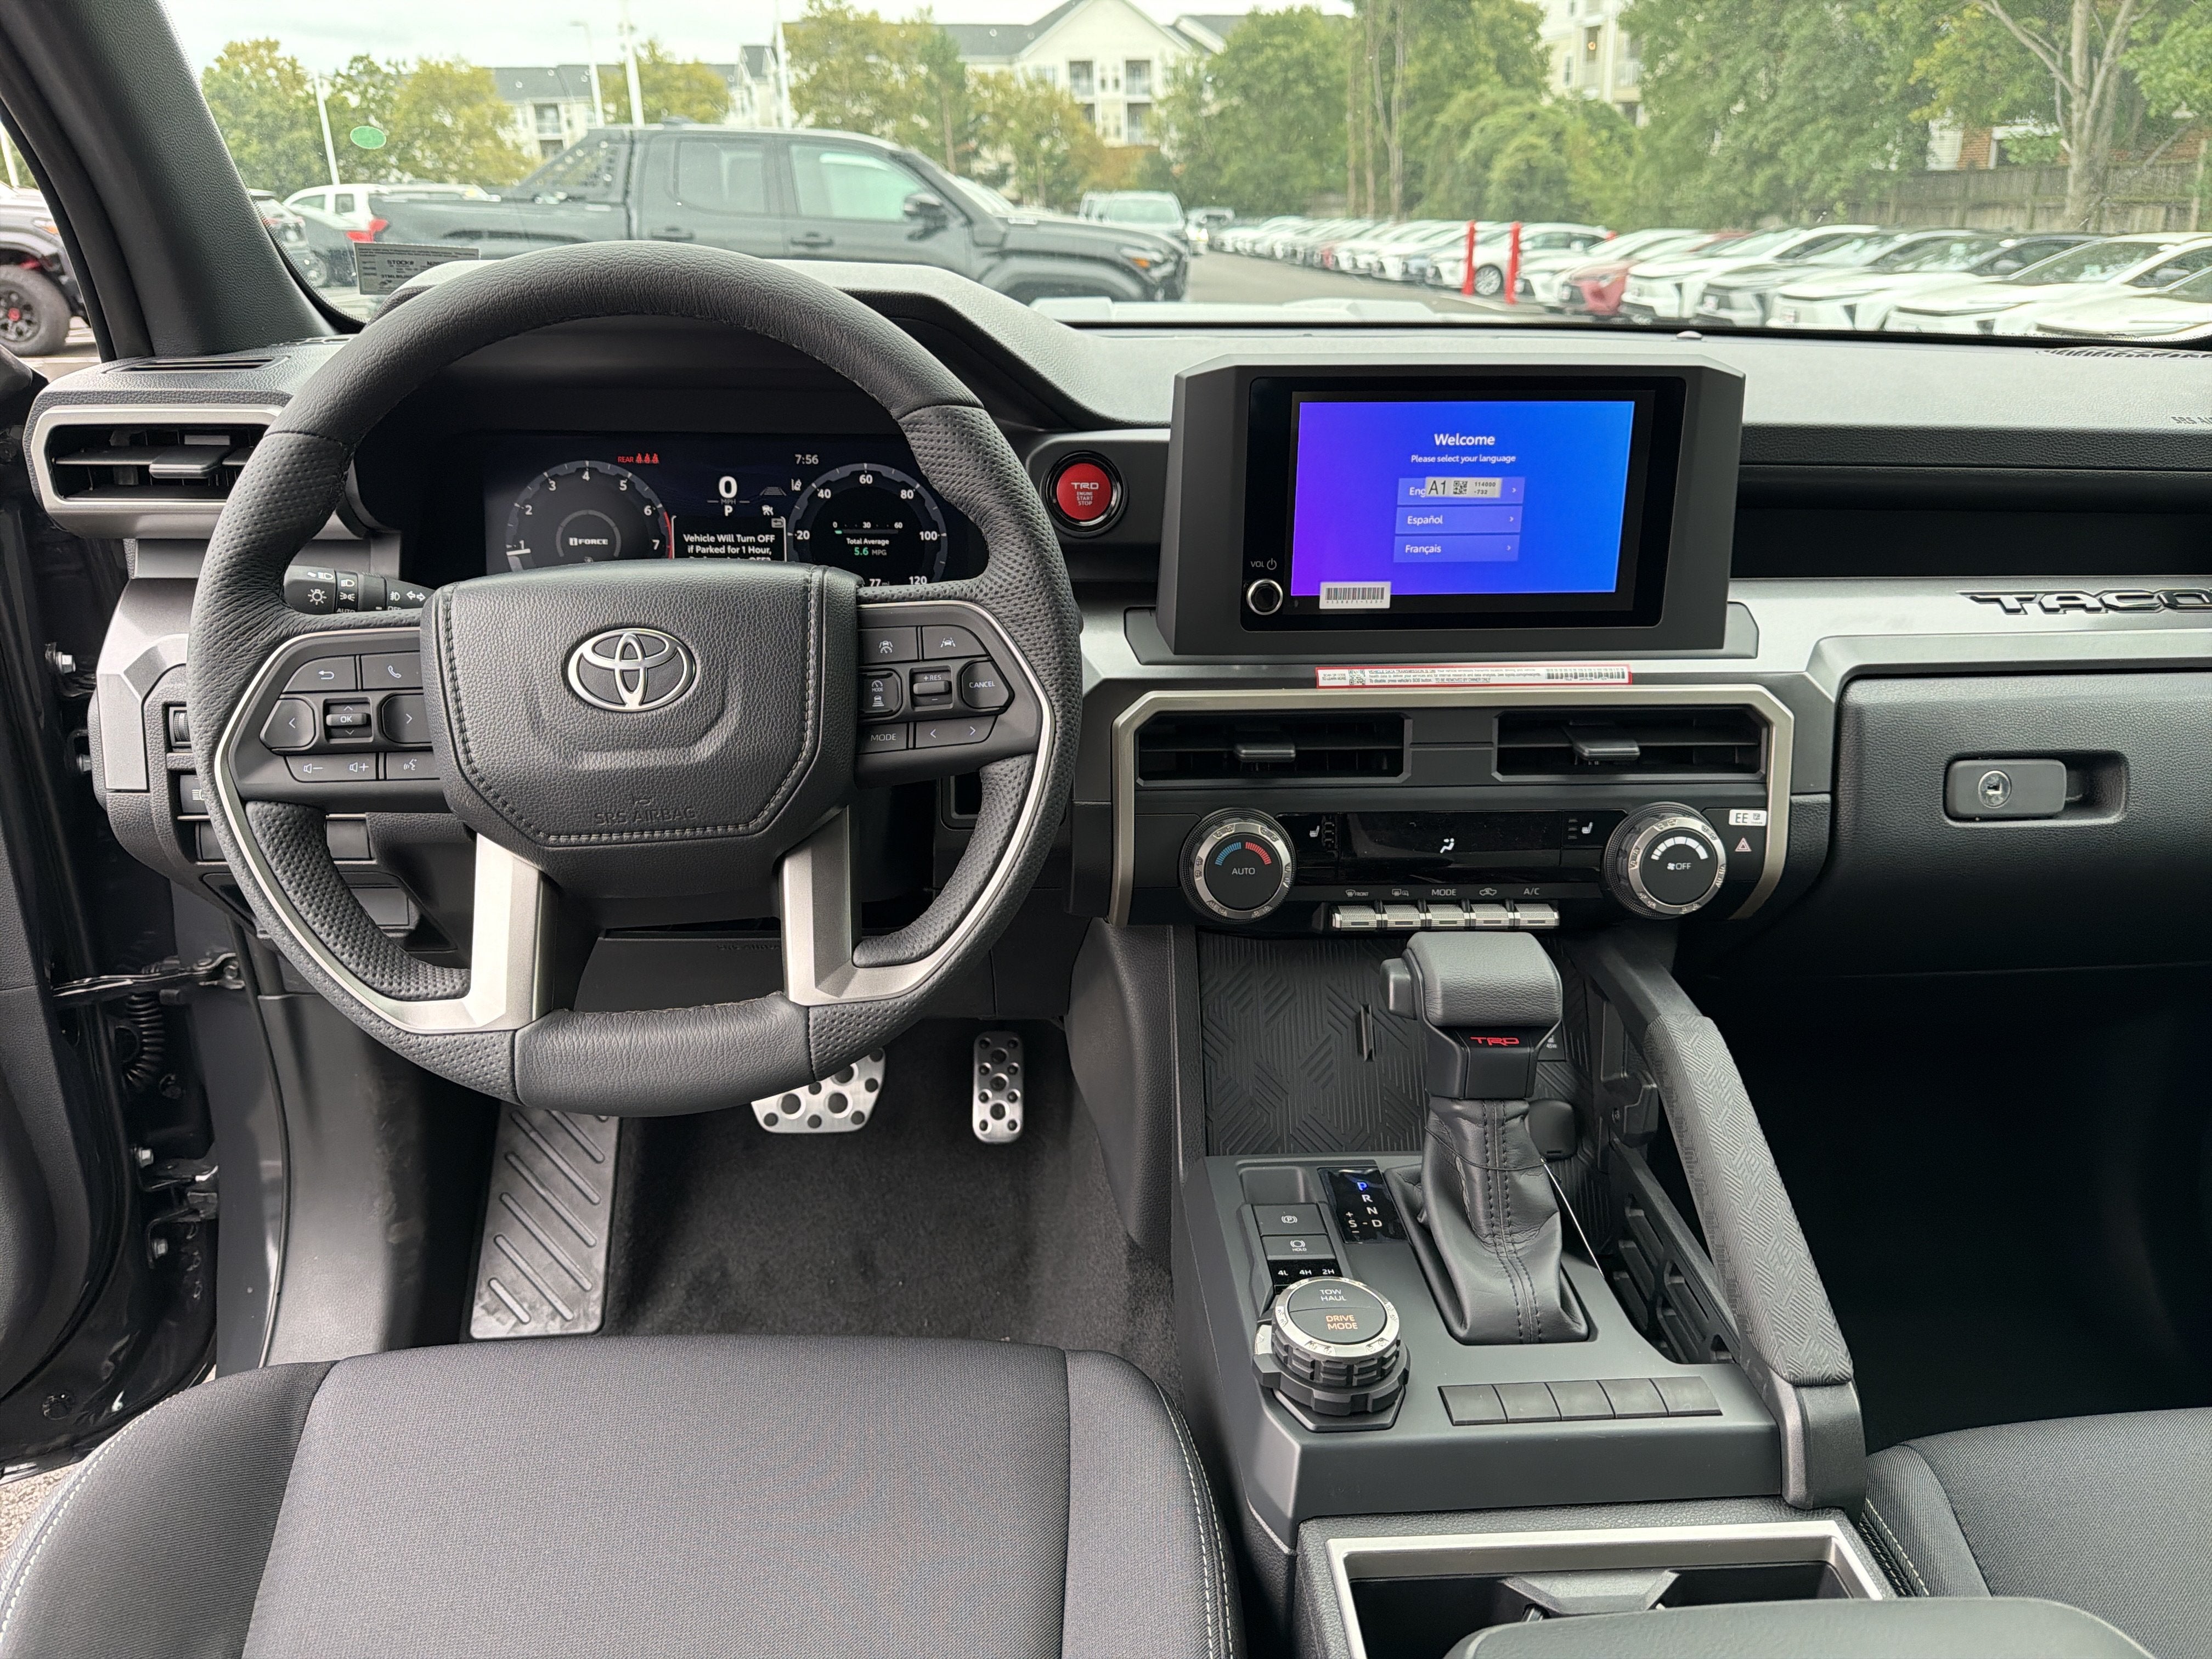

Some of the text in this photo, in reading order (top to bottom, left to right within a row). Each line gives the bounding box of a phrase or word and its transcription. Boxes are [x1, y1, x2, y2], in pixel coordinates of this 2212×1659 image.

[1434, 433, 1496, 446] Welcome
[794, 454, 819, 465] 7:56
[1437, 454, 1459, 462] select
[1460, 455, 1479, 464] your
[1480, 454, 1516, 464] language
[582, 471, 590, 481] 4
[859, 475, 873, 484] 60
[549, 480, 556, 491] 3
[619, 480, 627, 491] 5
[719, 476, 737, 498] 0
[1428, 480, 1447, 495] A1
[817, 489, 832, 499] 40
[900, 489, 914, 499] 80
[525, 506, 533, 515] 2
[644, 506, 652, 516] 6
[724, 505, 733, 516] P
[1407, 515, 1443, 526] Español
[683, 534, 775, 543] Vehicle Will Turn OFF
[797, 531, 810, 540] 20
[919, 531, 938, 541] 100
[519, 540, 525, 549] 1
[652, 540, 660, 550] 7
[864, 538, 889, 546] Average
[688, 545, 772, 555] if Parked for 1 Hour,
[854, 547, 869, 556] 5.6
[1405, 544, 1442, 555] Français
[869, 578, 881, 586] 77
[909, 575, 927, 585] 120
[595, 808, 697, 826] SRS AIRBAG
[1735, 813, 1748, 823] EE
[1470, 1037, 1520, 1046] TRD
[1357, 1181, 1368, 1191] P
[1362, 1194, 1373, 1203] R
[1348, 1220, 1357, 1228] S
